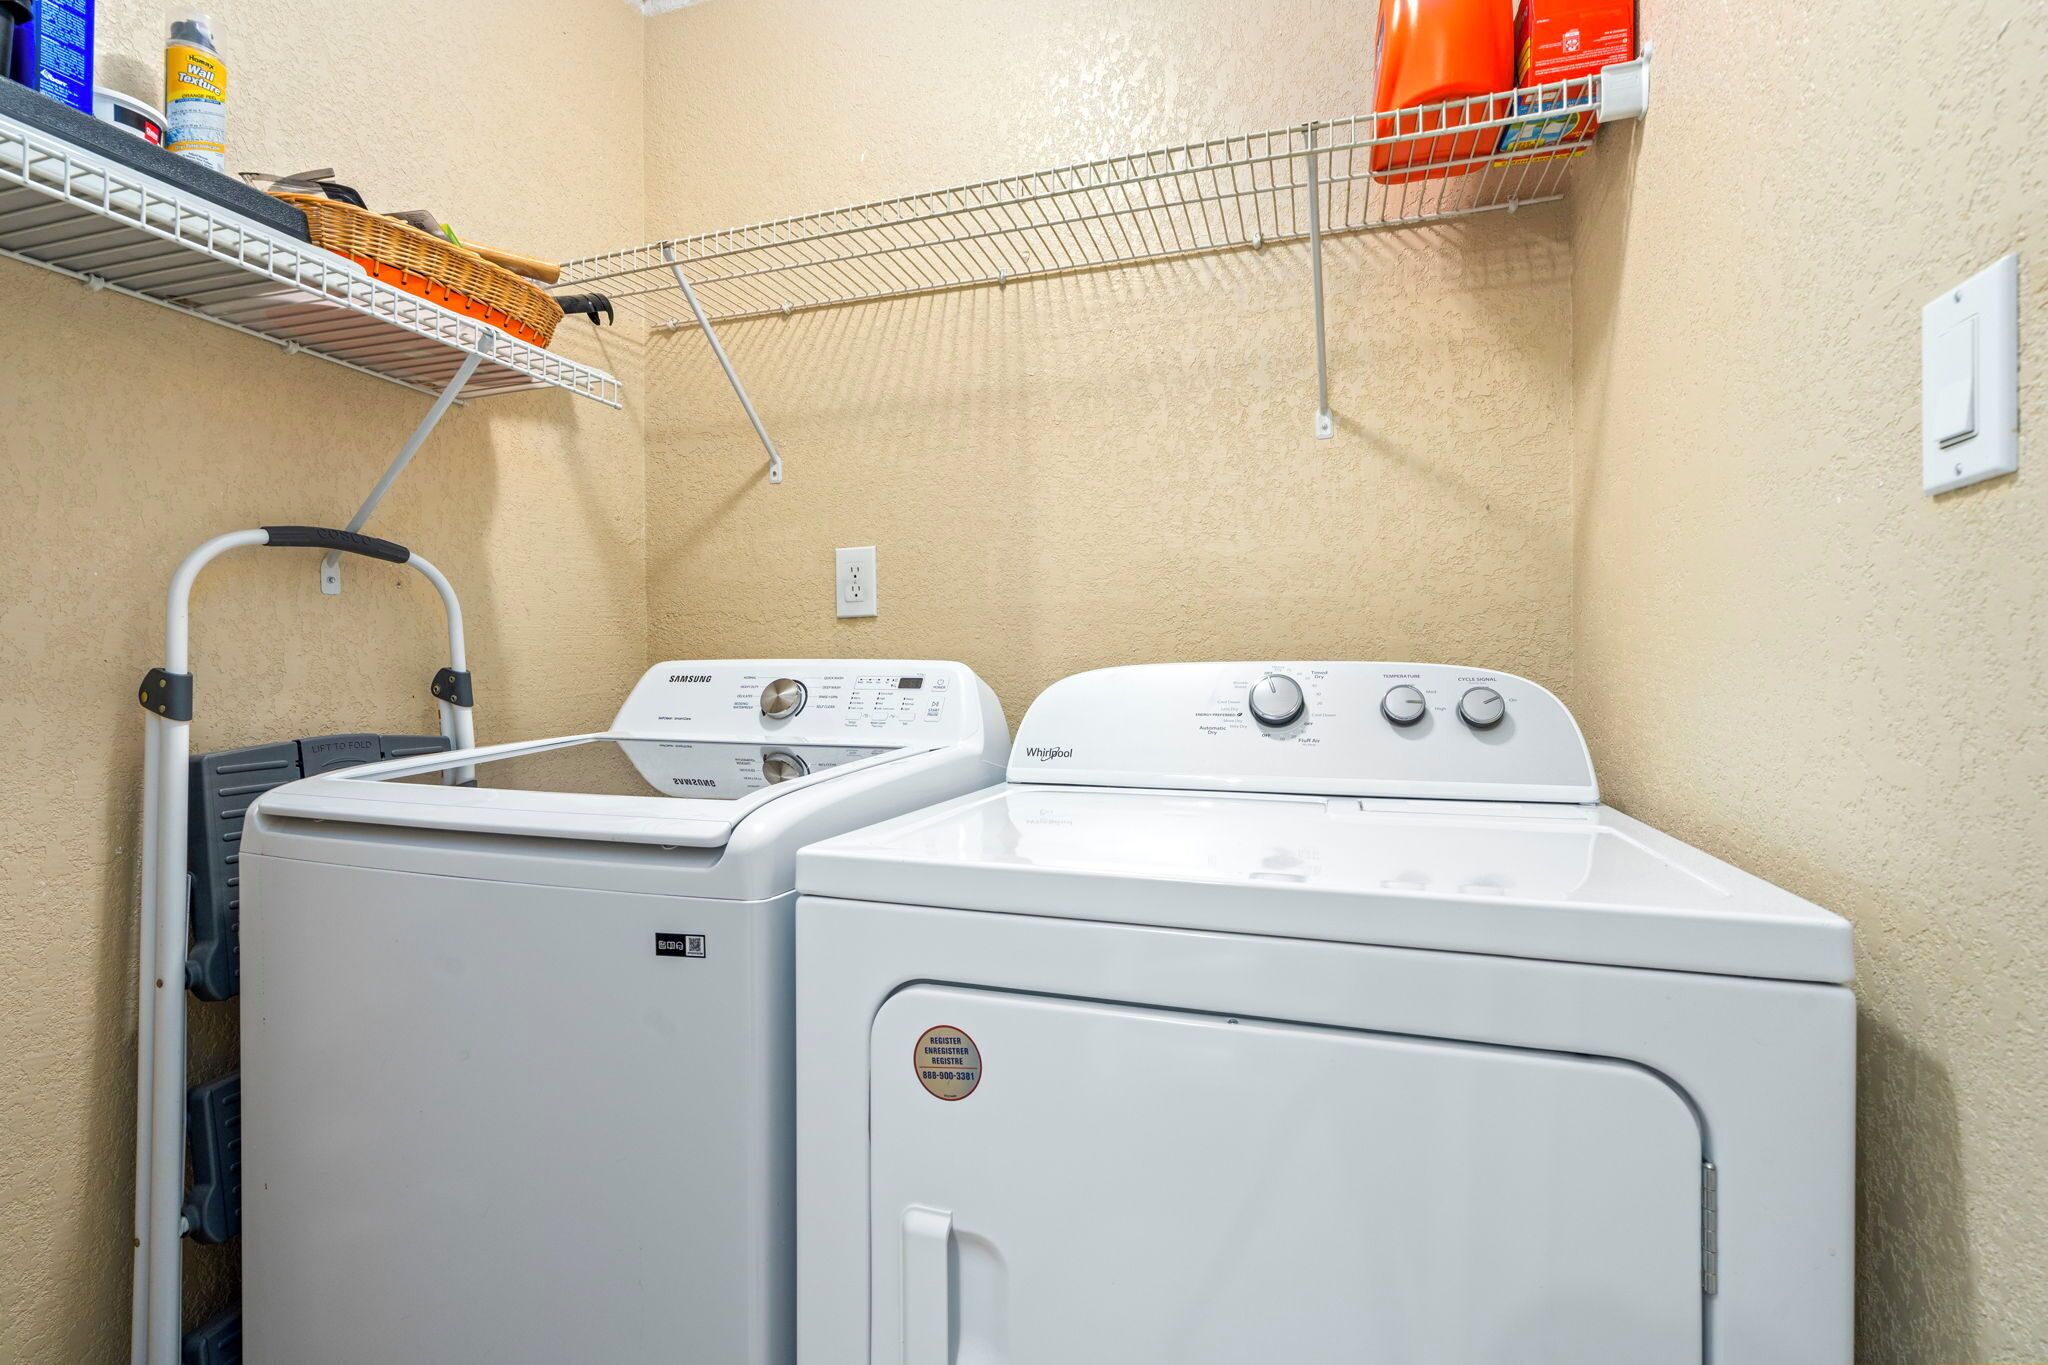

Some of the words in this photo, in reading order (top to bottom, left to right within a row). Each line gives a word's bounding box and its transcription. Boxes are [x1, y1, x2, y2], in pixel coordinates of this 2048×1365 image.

[188, 54, 214, 69] Homax
[187, 63, 215, 82] Wall
[179, 72, 221, 96] Texture
[669, 675, 712, 683] SAMSUNG
[312, 743, 331, 753] LIFT
[333, 742, 346, 750] TO
[348, 741, 372, 750] FOLD
[1026, 747, 1073, 761] Whirlpool
[930, 1037, 962, 1045] REGISTER
[924, 1047, 969, 1055] ENREGISTRER
[931, 1057, 963, 1065] REGISTRE
[922, 1071, 975, 1080] 888-900-3381
